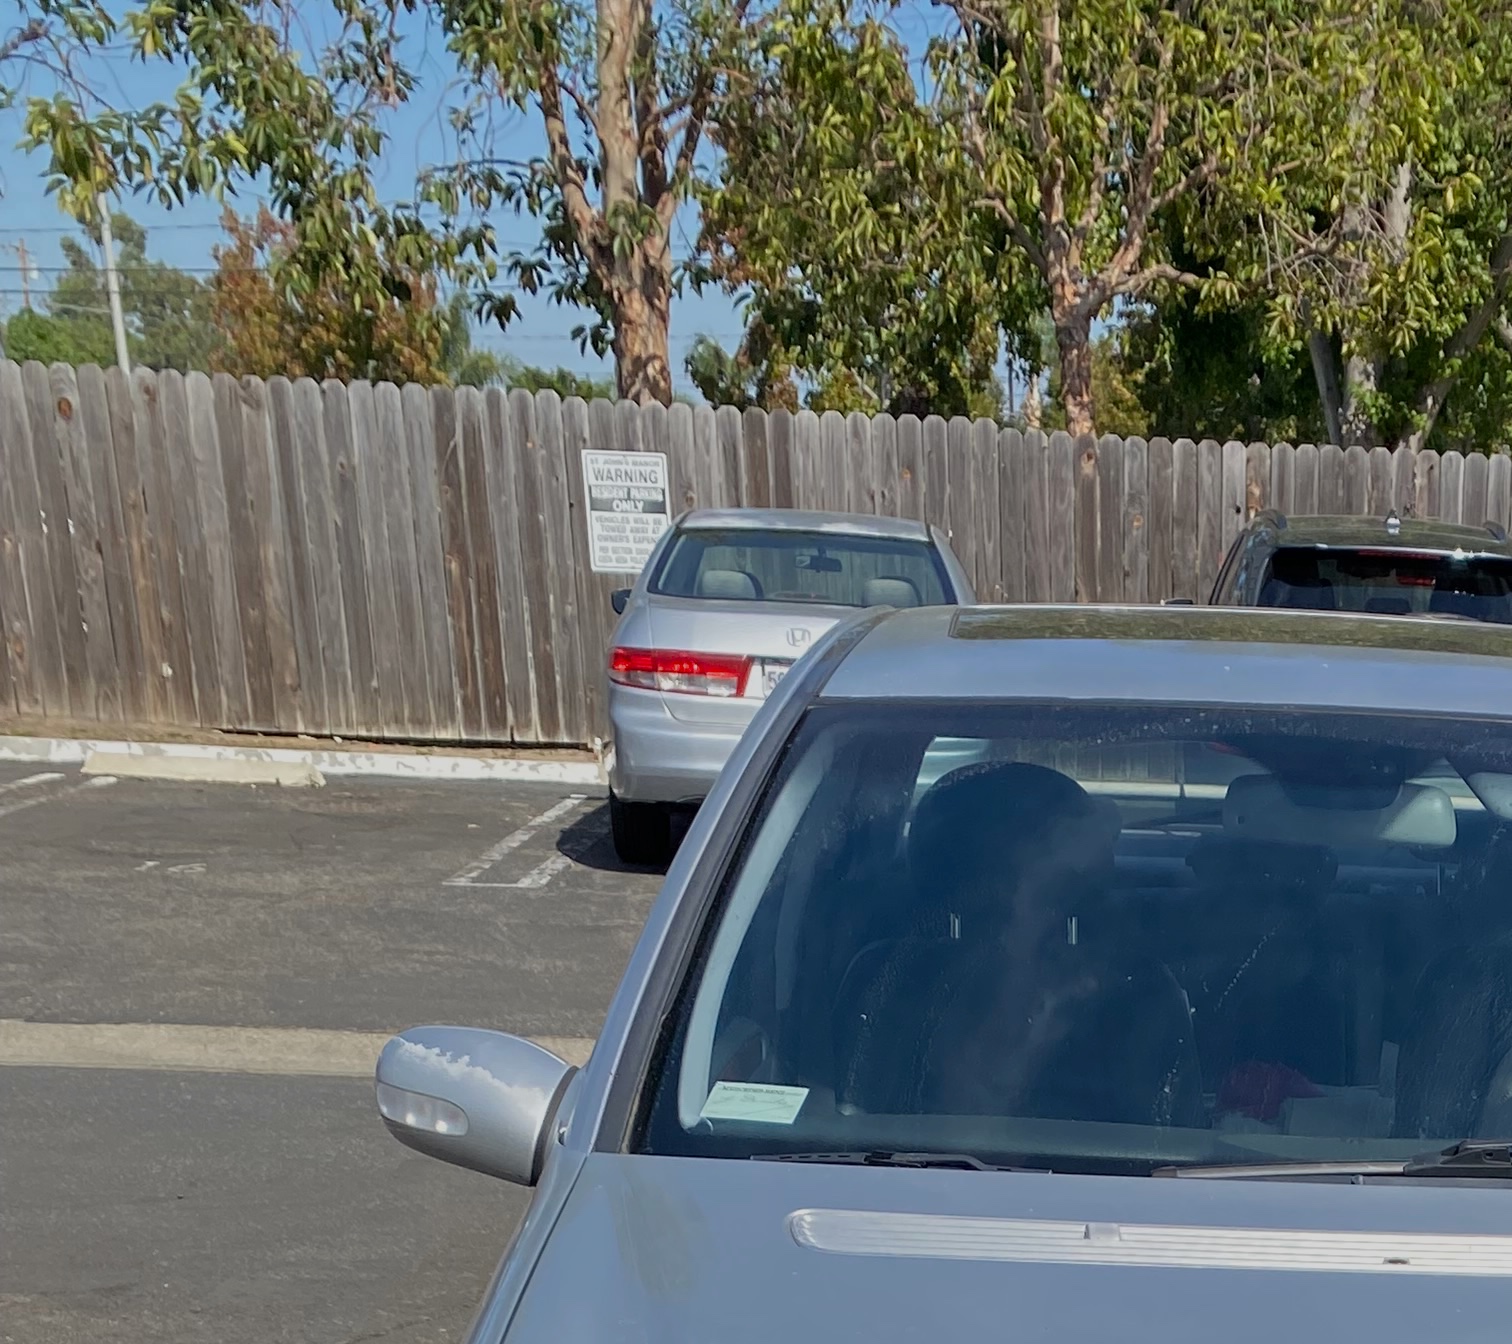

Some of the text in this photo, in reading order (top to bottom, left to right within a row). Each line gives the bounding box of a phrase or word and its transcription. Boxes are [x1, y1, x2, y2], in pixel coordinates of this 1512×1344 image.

[593, 467, 658, 484] WARNING
[591, 485, 664, 502] RESIDENT PARKING
[612, 499, 645, 513] ONLY
[595, 516, 662, 526] VEHICLES WILL BE
[600, 525, 660, 535] TOWED AWAY AT
[597, 534, 657, 544] OWNER'S EXPEN
